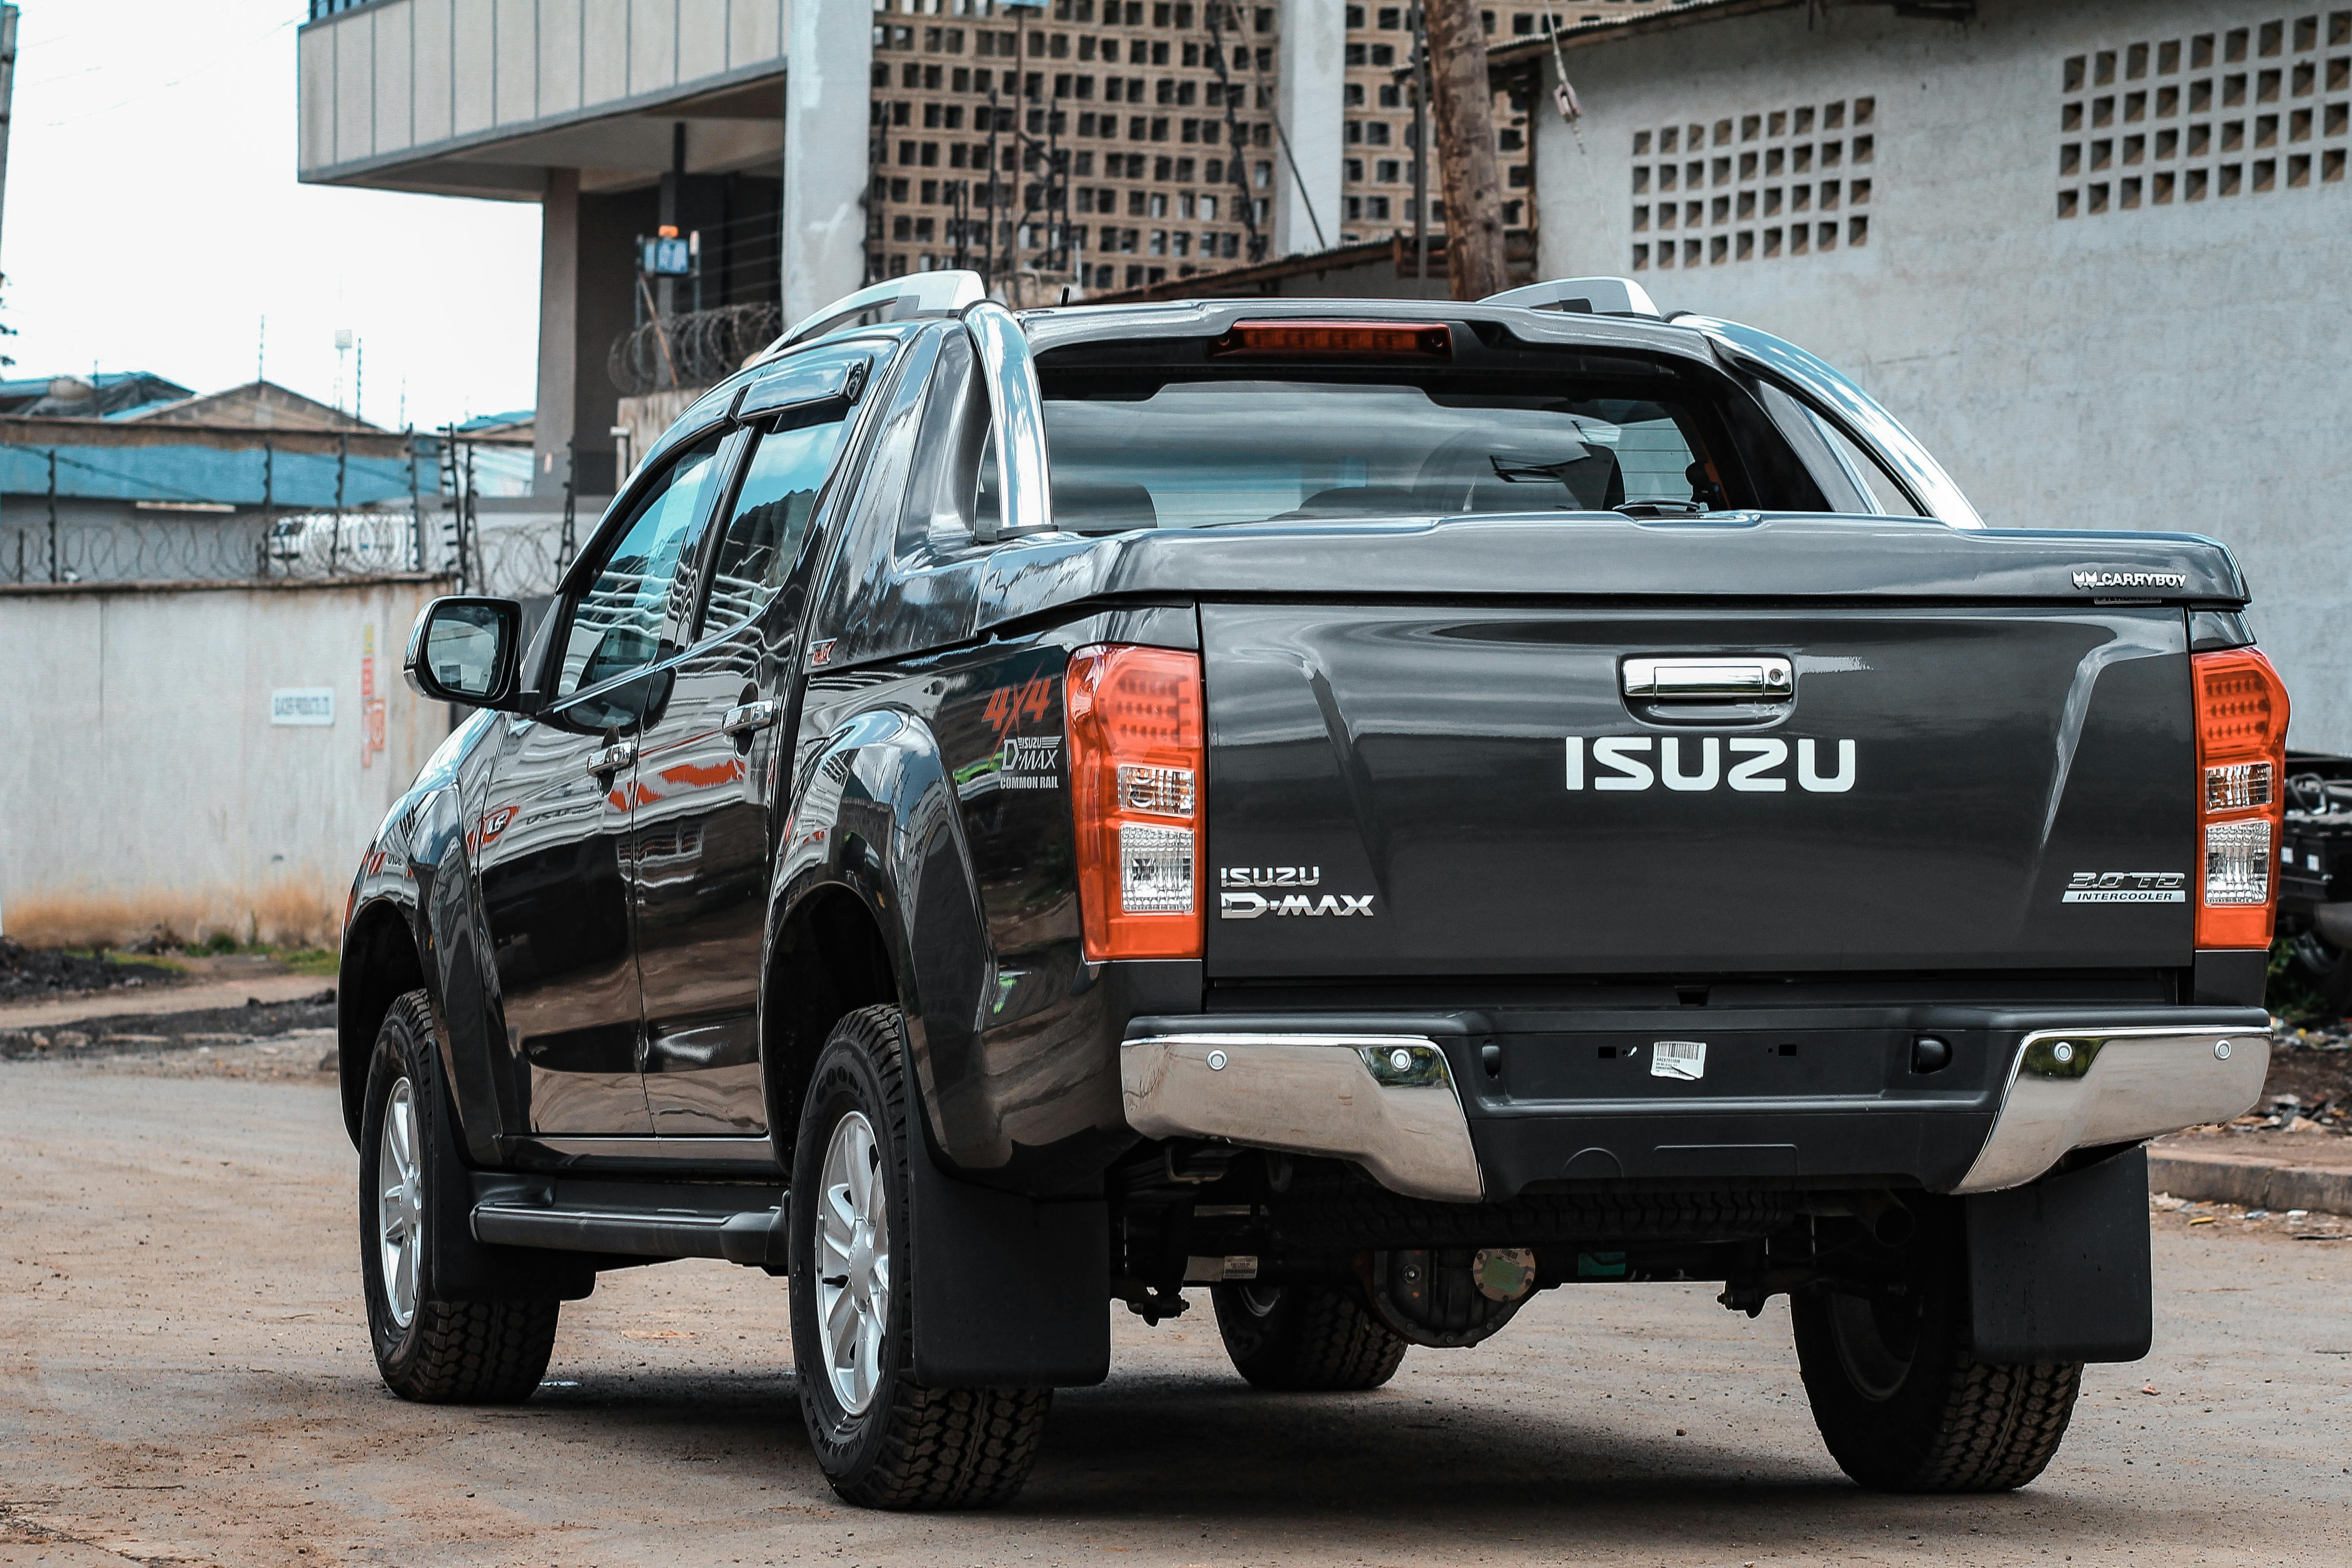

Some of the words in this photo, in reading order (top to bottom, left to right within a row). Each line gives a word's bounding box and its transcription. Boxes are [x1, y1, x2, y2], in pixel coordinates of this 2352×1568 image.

[2101, 572, 2187, 588] CARRYBOY
[1022, 736, 1043, 749] ISUZU
[1565, 736, 1856, 793] ISUZU
[1000, 776, 1038, 789] COMMON
[1040, 776, 1059, 789] RAIL
[1220, 866, 1319, 887] ISUZU
[2068, 872, 2125, 889] 3.0
[1221, 892, 1374, 919] D-MAX
